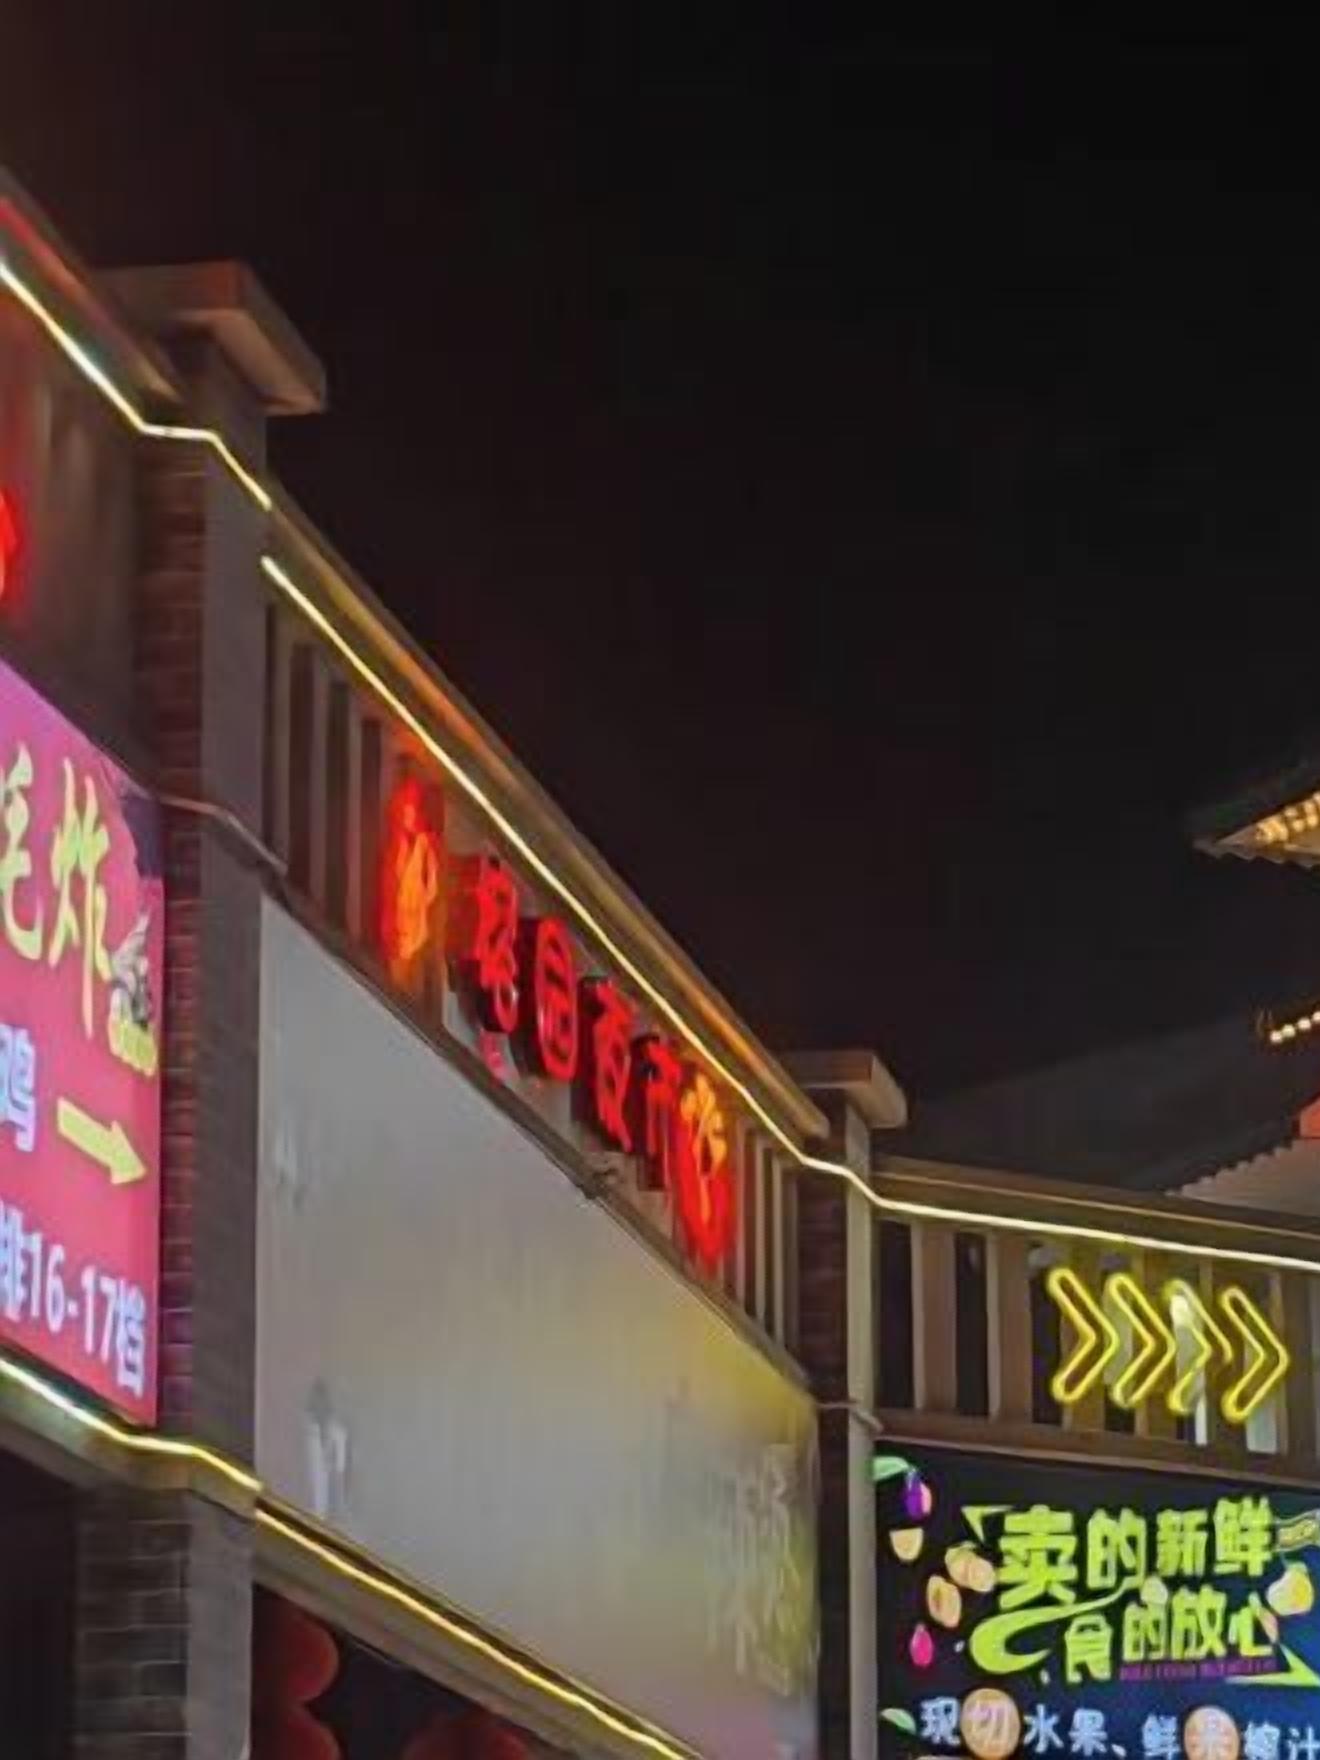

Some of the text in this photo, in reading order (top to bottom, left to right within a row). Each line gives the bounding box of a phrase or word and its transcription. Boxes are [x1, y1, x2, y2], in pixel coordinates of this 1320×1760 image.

[1000, 1496, 1273, 1608] 卖的新鲜
[1064, 1582, 1278, 1684] 食的放心
